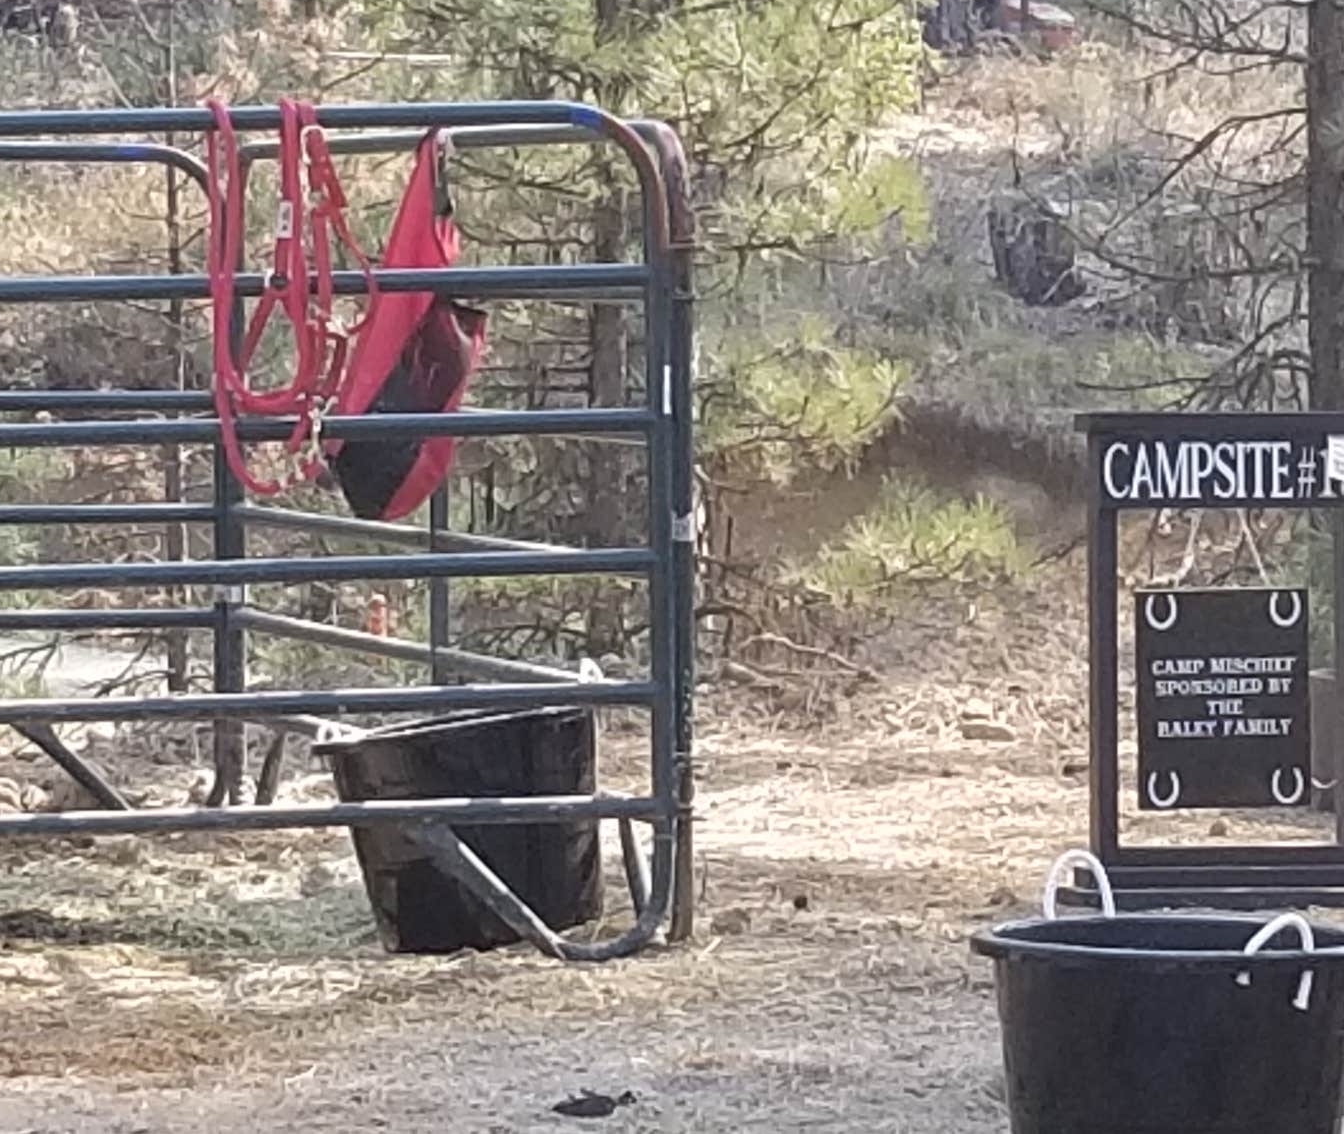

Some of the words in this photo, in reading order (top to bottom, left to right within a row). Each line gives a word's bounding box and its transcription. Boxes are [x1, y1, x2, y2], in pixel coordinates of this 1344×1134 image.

[1104, 441, 1294, 499] CAMPSITE
[1152, 660, 1204, 675] CAMP
[1210, 657, 1296, 674] MISCHIEF
[1155, 679, 1263, 697] SPONSORED
[1268, 678, 1292, 694] BY
[1206, 699, 1243, 715] THE
[1223, 718, 1292, 736] FAMILY
